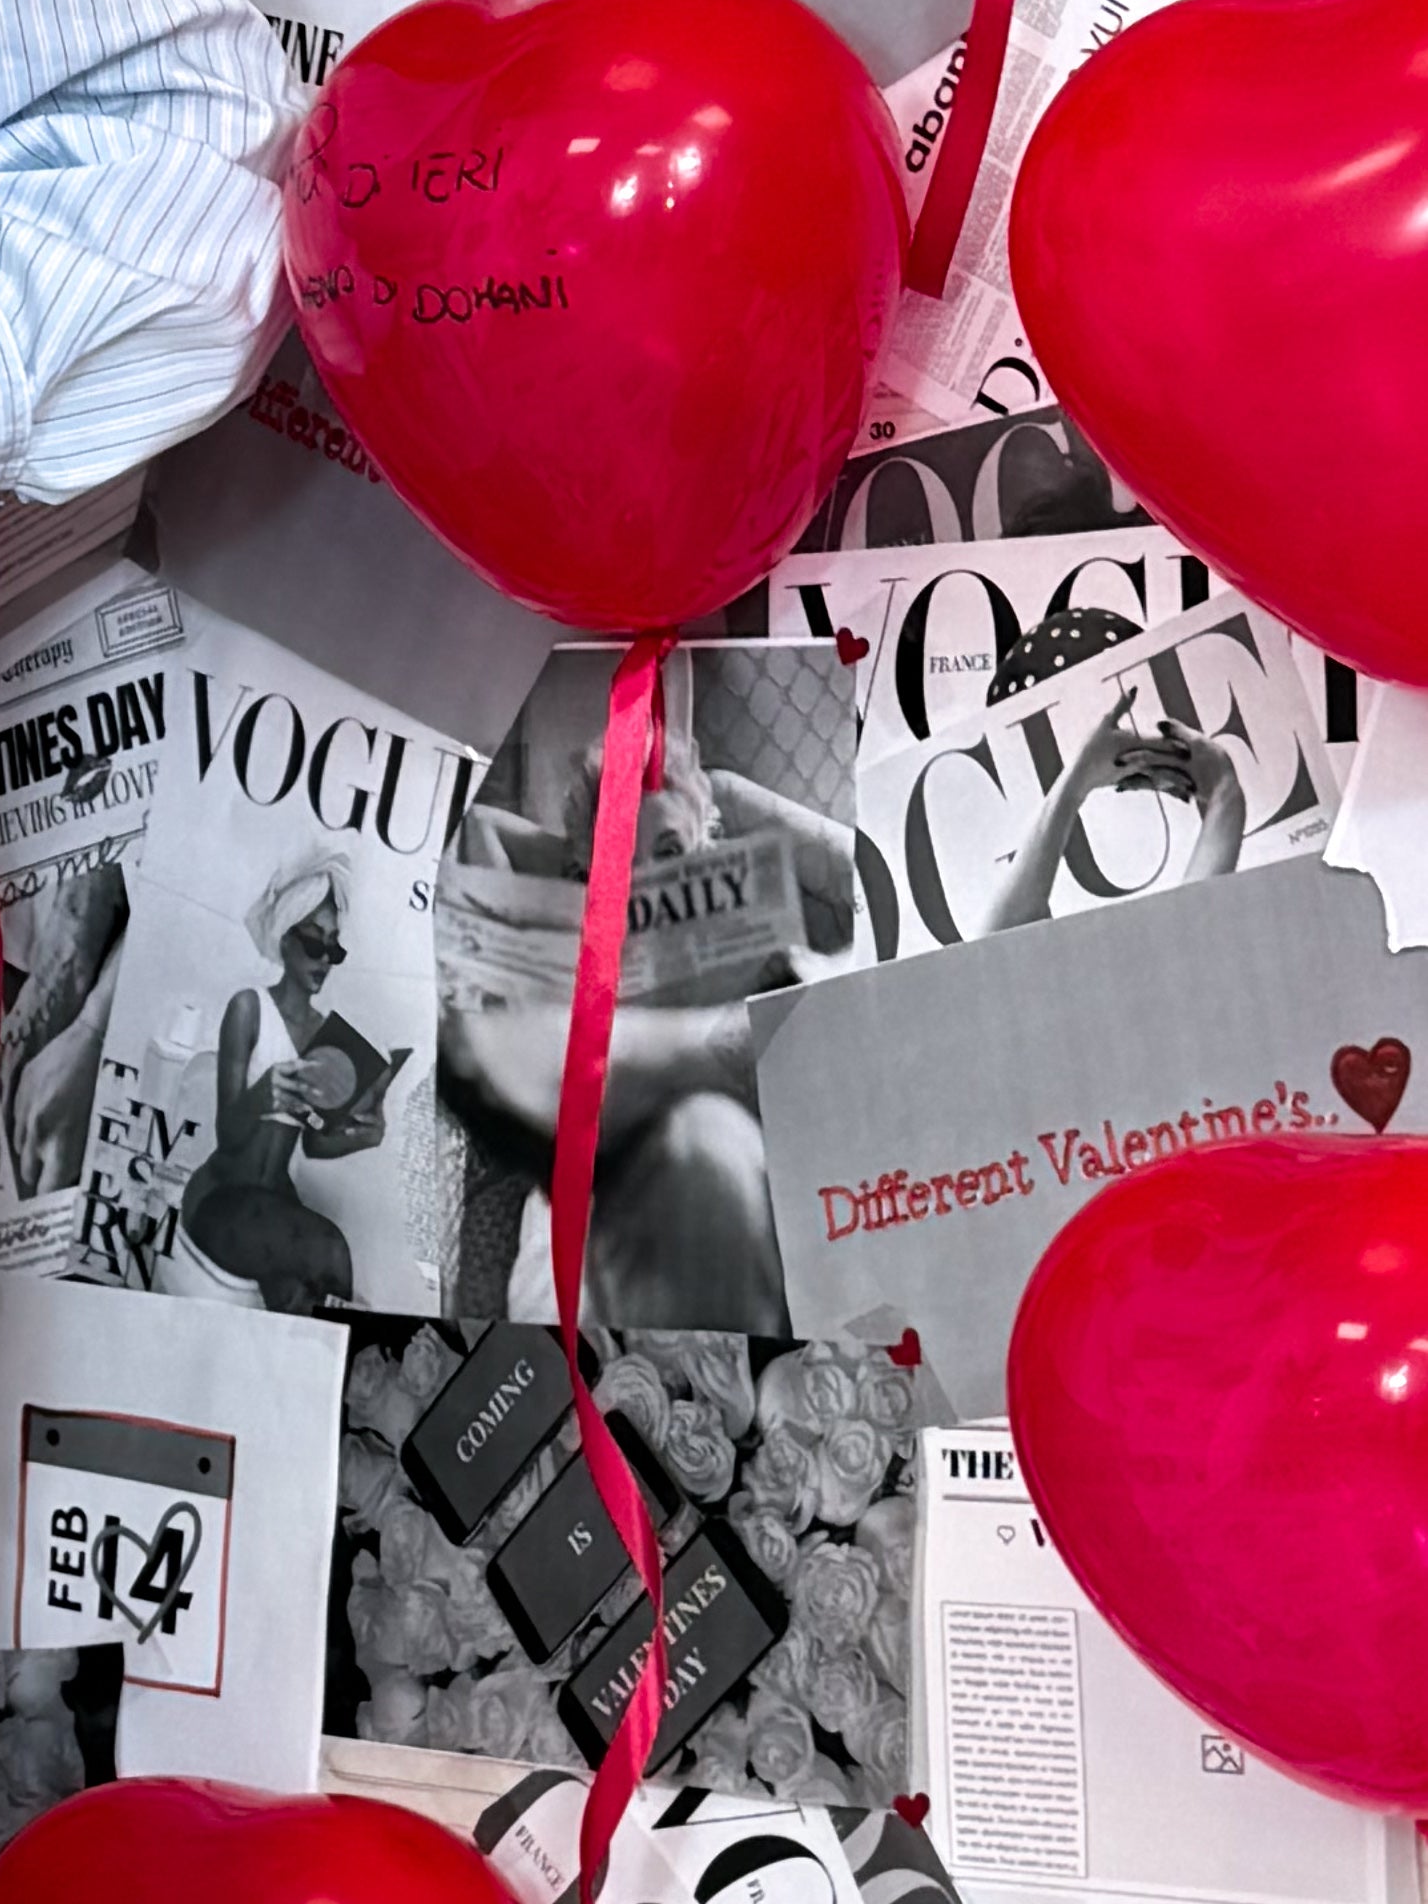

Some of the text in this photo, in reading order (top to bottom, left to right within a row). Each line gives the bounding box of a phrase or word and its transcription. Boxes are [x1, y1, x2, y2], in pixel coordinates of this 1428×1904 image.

[927, 651, 995, 675] FRANCE
[92, 670, 167, 760] DAY
[627, 869, 753, 935] DAILY
[818, 1149, 1036, 1243] Different
[454, 1358, 538, 1465] COMING
[941, 1448, 1015, 1482] THE
[46, 1504, 90, 1614] FEB
[92, 1515, 195, 1635] 14
[565, 1520, 595, 1557] IS
